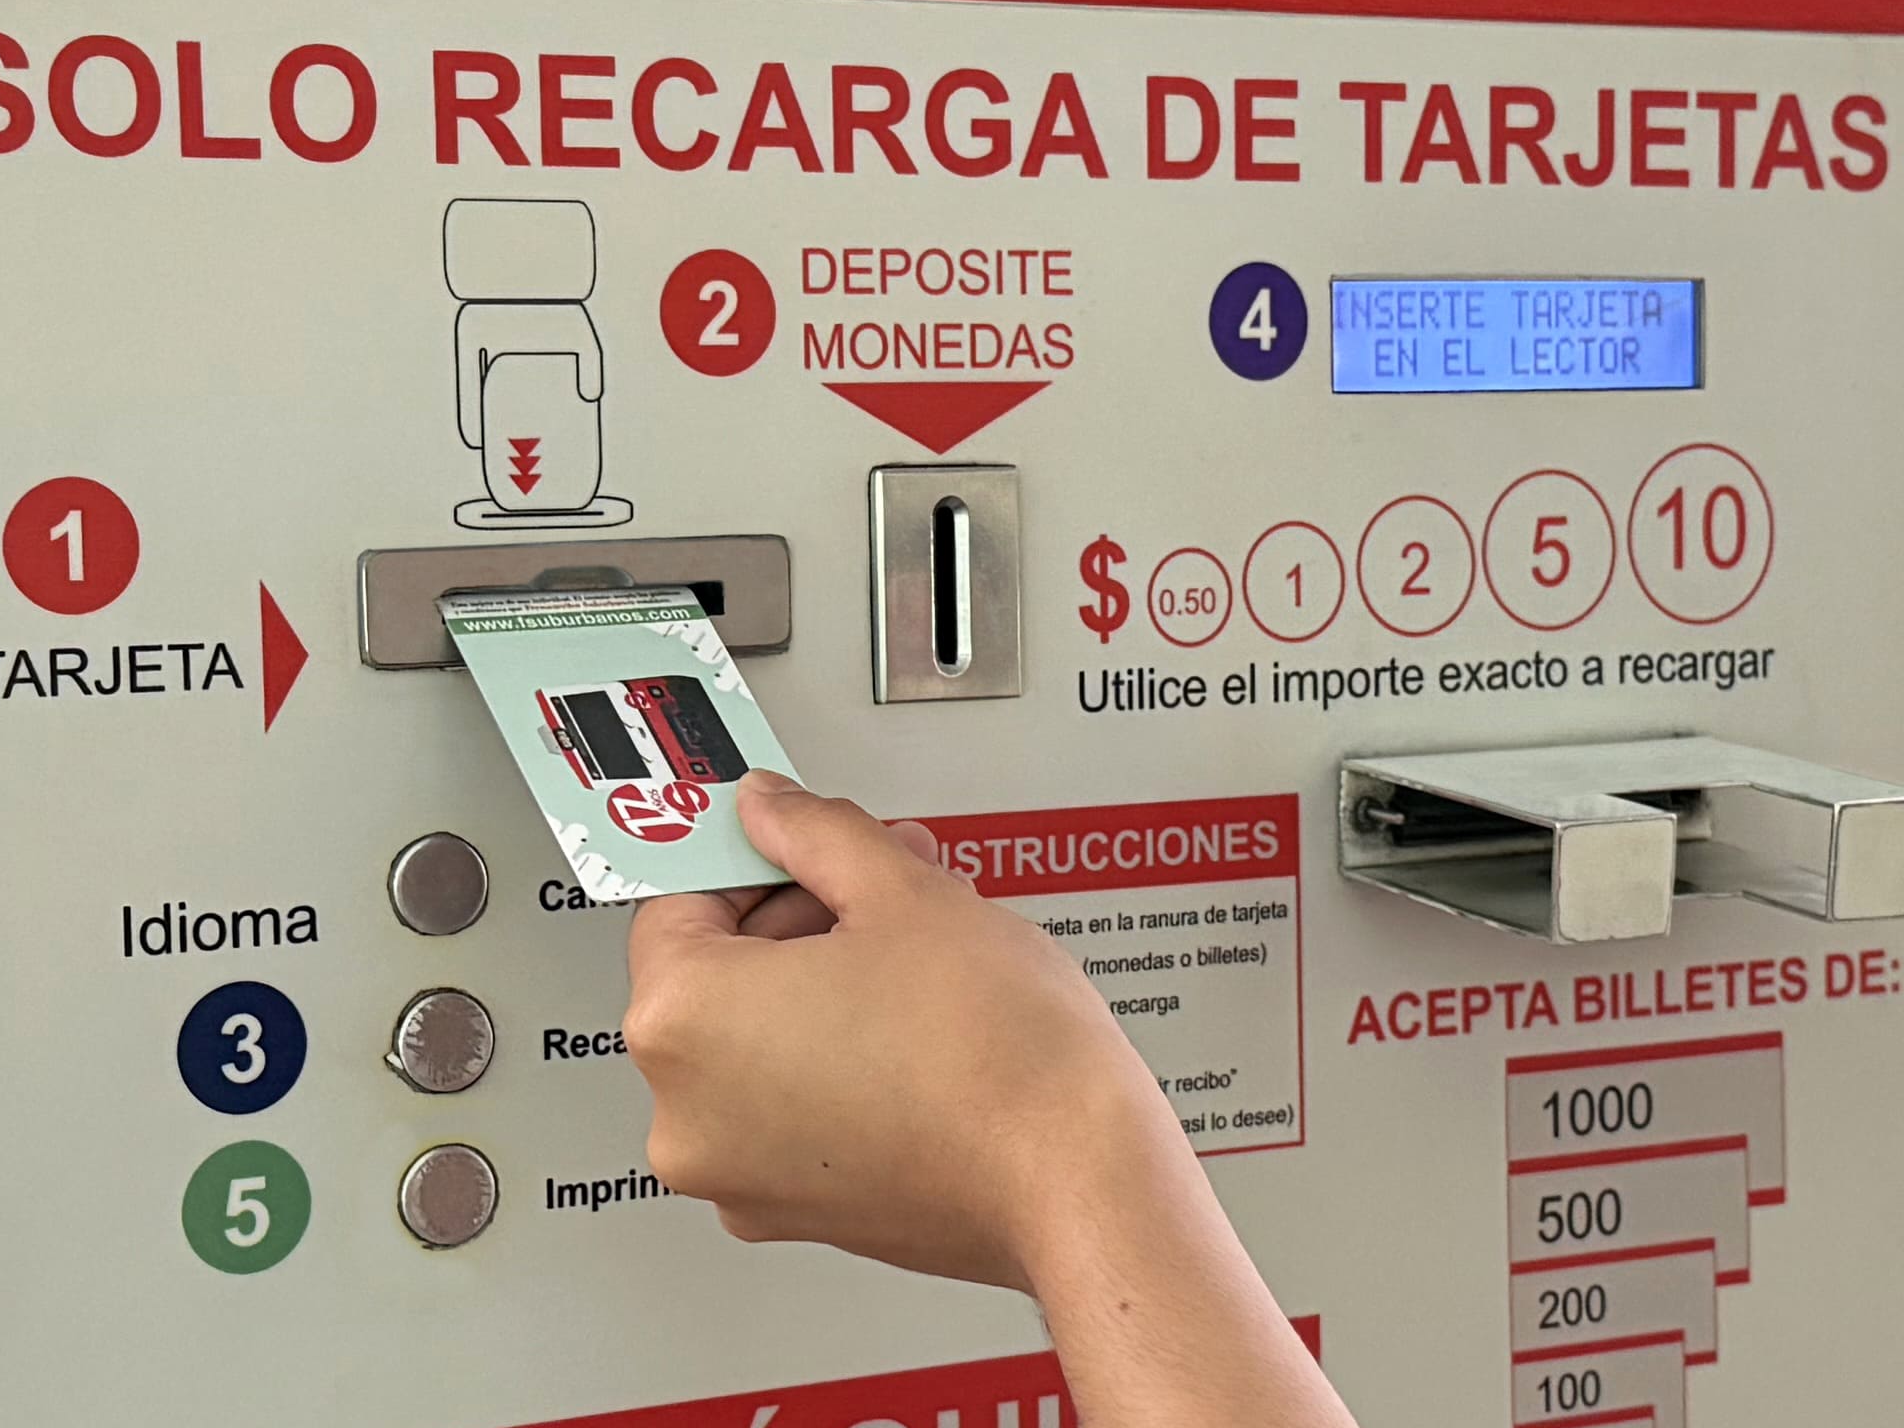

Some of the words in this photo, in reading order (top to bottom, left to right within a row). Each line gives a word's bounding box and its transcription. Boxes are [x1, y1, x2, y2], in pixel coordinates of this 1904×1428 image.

[433, 50, 1108, 178] RECARGA
[1147, 76, 1300, 182] DE
[1340, 82, 1888, 191] TARJETAS
[802, 248, 1073, 296] DEPOSITE
[699, 281, 739, 345] 2
[1240, 289, 1277, 350] 4
[1332, 287, 1485, 333] INSERTE
[1511, 289, 1663, 333] TARJETA
[804, 323, 1074, 370] MONEDAS
[1375, 338, 1417, 377] EN
[1444, 338, 1485, 376] EL
[1511, 337, 1640, 375] LECTOR
[51, 510, 83, 581] 1
[1079, 534, 1130, 644] $
[1159, 585, 1216, 617] 0.50
[1286, 564, 1301, 607] 1
[1401, 542, 1430, 596] 2
[1532, 516, 1570, 587] 5
[1657, 485, 1746, 570] 10
[1079, 668, 1206, 713] Utilice
[1223, 663, 1255, 705] el
[1274, 658, 1424, 711] importe
[1439, 651, 1568, 692] exacto
[1582, 656, 1603, 685] a
[1620, 649, 1774, 690] recargar
[940, 820, 1279, 880] STRUCCIONES
[123, 902, 318, 957] Idioma
[1089, 918, 1111, 933] en
[1118, 913, 1133, 931] la
[1140, 911, 1198, 929] ranura
[1205, 906, 1227, 924] de
[1233, 902, 1287, 924] tarjeta
[1083, 952, 1174, 977] (monedas
[1180, 954, 1191, 967] o
[1197, 943, 1266, 966] billetes)
[1110, 996, 1180, 1016] recarga
[1348, 981, 1558, 1044] ACEPTA
[1575, 958, 1807, 1022] BILLETES
[1826, 950, 1899, 997] DE:
[221, 1013, 265, 1083] 3
[1211, 1113, 1227, 1130] lo
[1233, 1105, 1293, 1128] desee)
[1544, 1083, 1652, 1138] 1000
[225, 1176, 269, 1246] 5
[1539, 1188, 1621, 1243] 500
[1540, 1285, 1606, 1329] 200
[1539, 1370, 1600, 1412] 100
